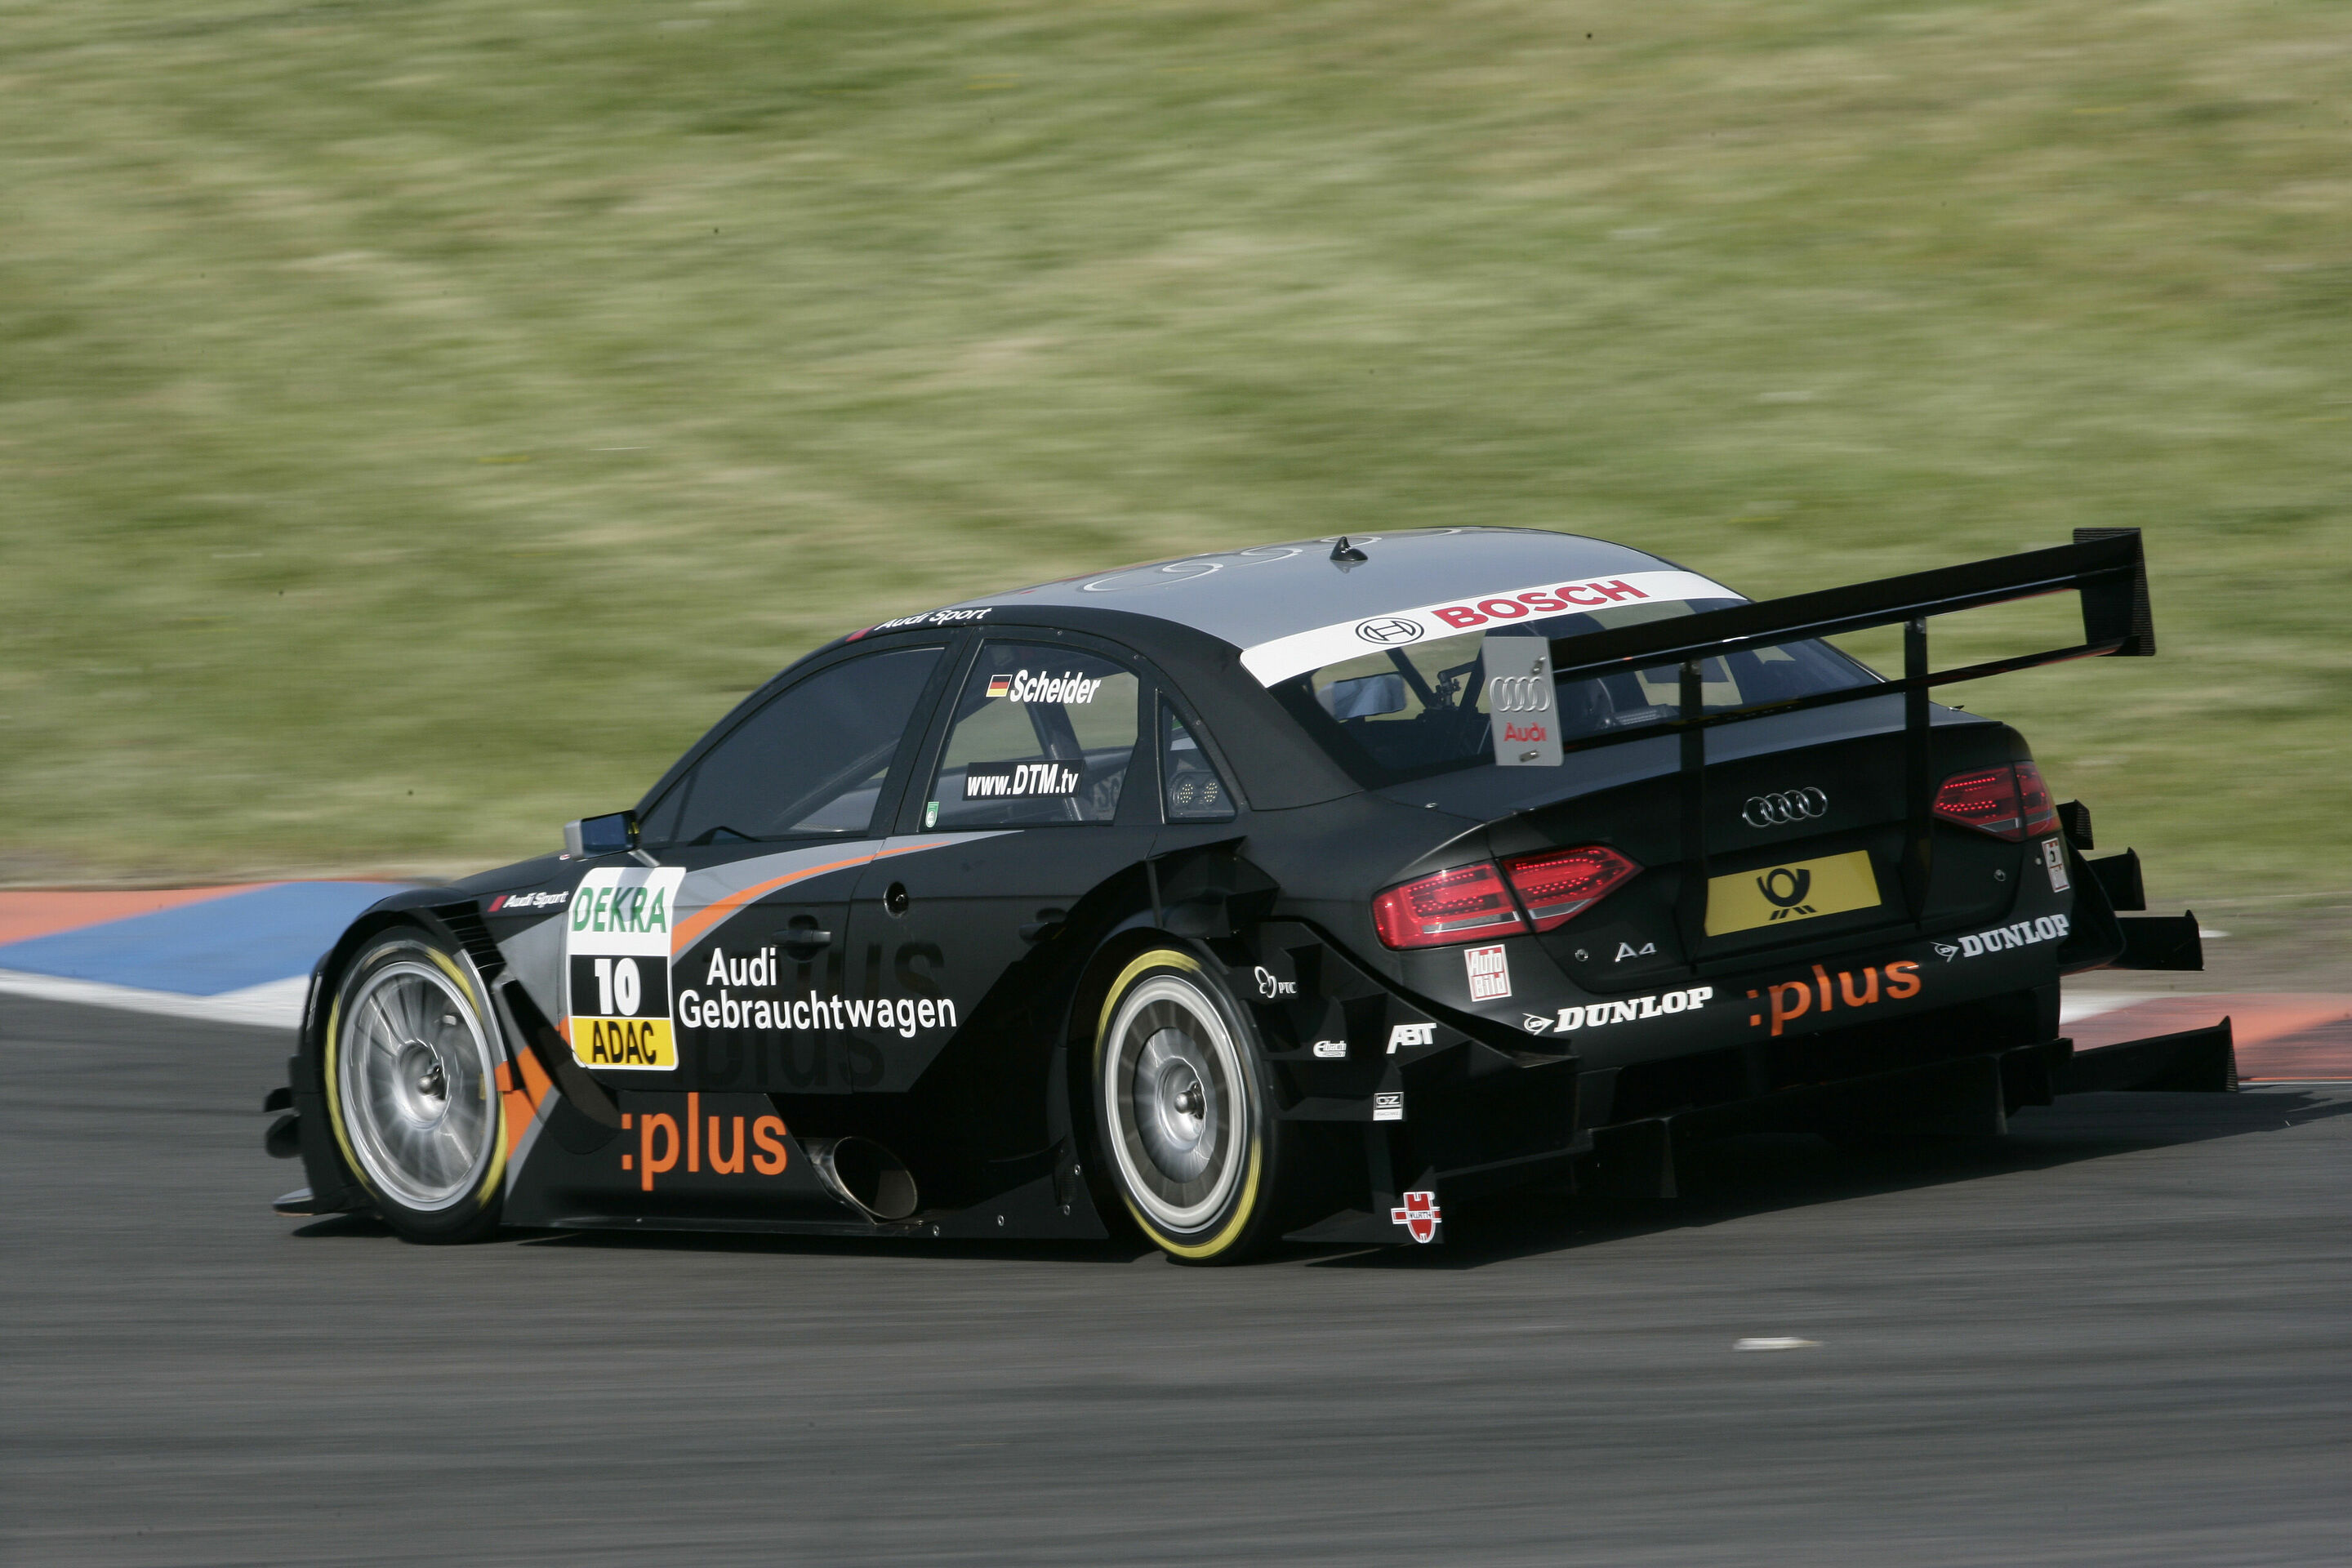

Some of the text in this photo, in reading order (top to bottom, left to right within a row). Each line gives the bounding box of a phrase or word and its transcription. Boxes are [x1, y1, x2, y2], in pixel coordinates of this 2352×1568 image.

[874, 608, 992, 630] Audi Sport
[1432, 581, 1648, 629] BOSCH
[1009, 669, 1102, 704] Scheider
[1503, 722, 1547, 742] Audi
[967, 764, 1079, 796] www.DTM.tv
[573, 887, 667, 933] DEKRA
[1615, 942, 1656, 963] A4
[1958, 913, 2069, 958] DUNLOP
[594, 958, 642, 1016] 10
[706, 947, 777, 987] Audi
[679, 989, 957, 1038] Gebrauchtwagen
[1553, 986, 1713, 1033] DUNLOP
[592, 1020, 657, 1065] ADAC
[1386, 1022, 1437, 1054] ABT
